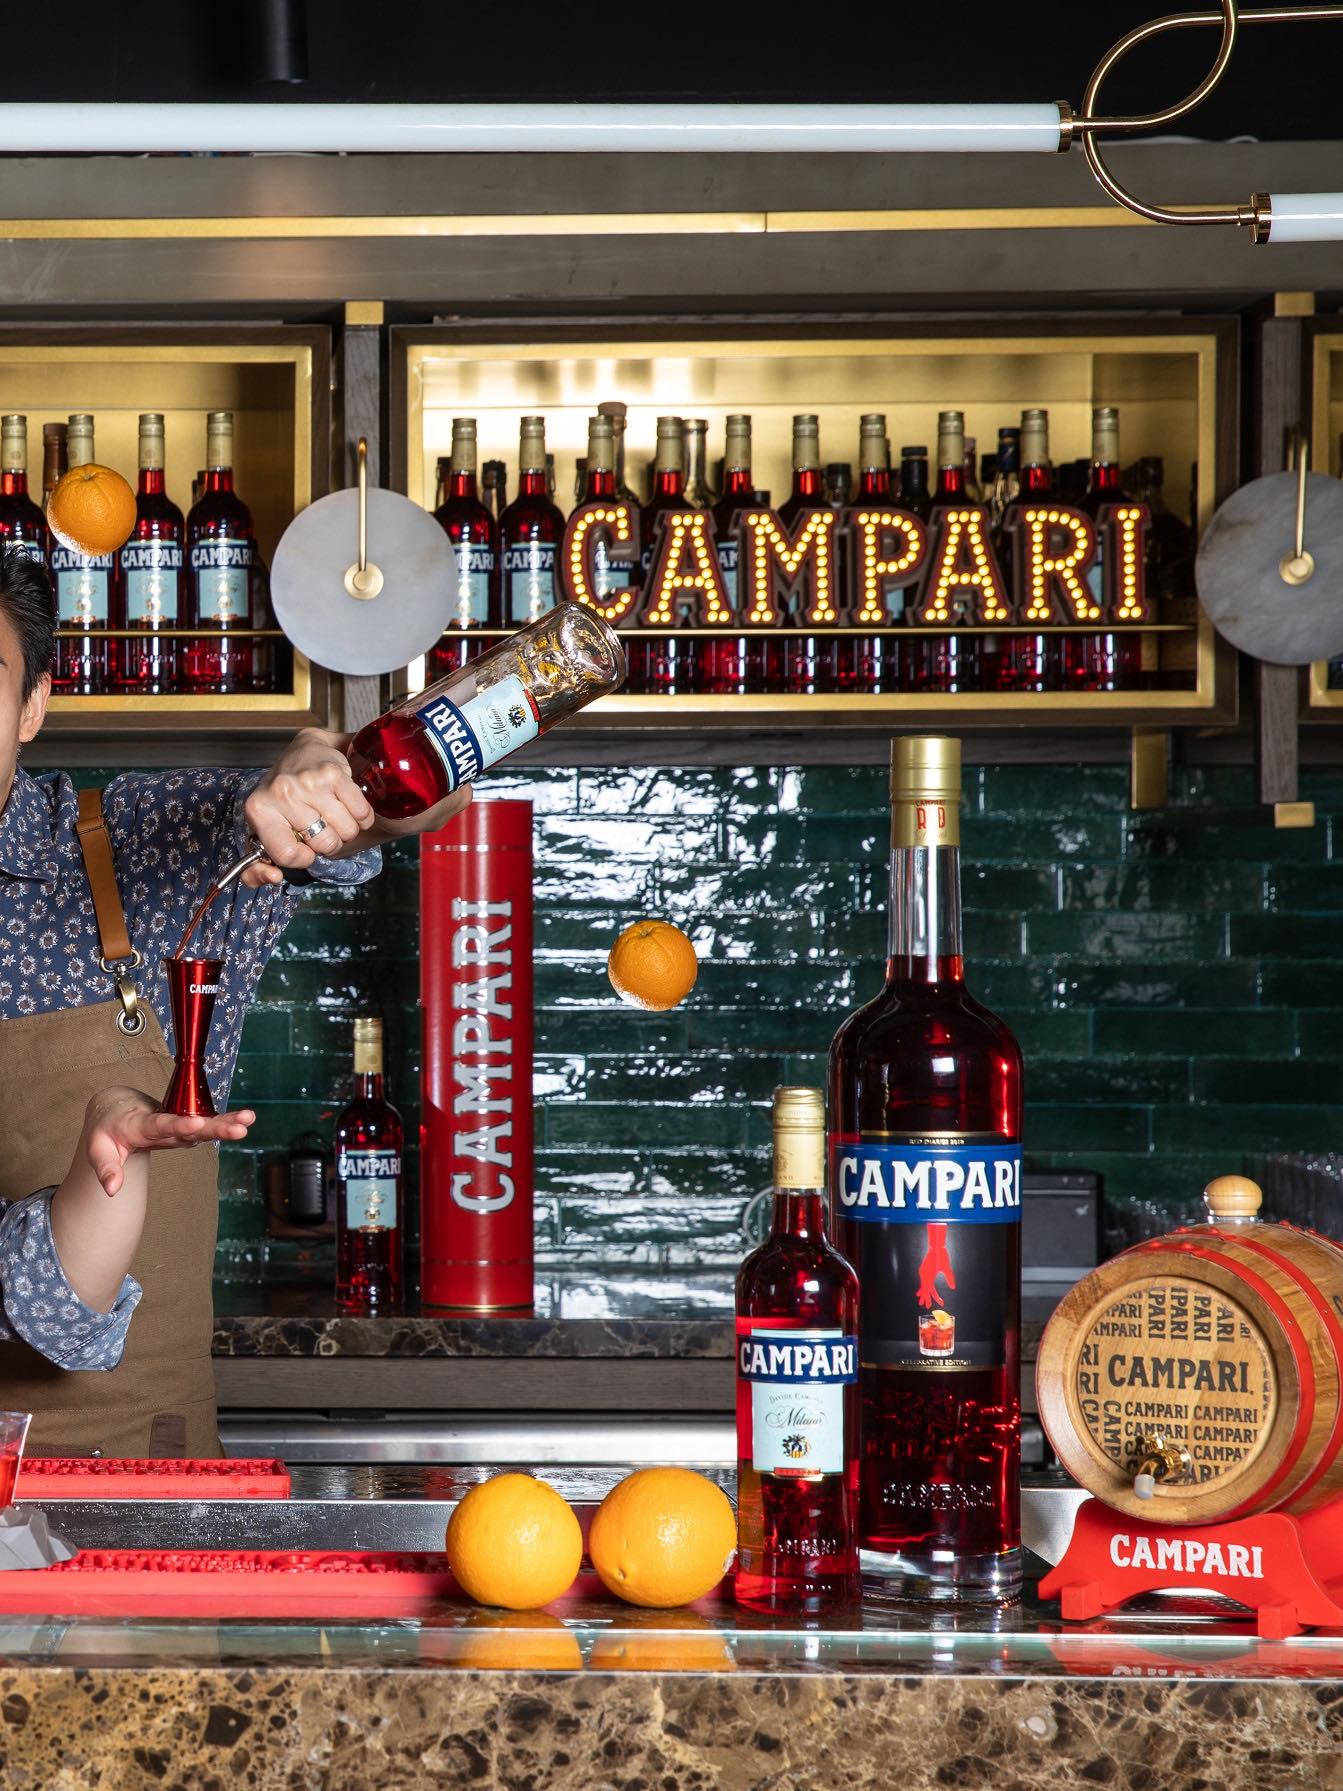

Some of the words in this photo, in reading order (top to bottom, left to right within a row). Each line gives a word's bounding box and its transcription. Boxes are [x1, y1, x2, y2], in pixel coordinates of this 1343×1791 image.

[121, 548, 183, 568] CAMPARI
[192, 547, 253, 567] CAMPARI
[562, 502, 1149, 626] CAMPARI
[424, 703, 478, 787] AMPARI
[451, 896, 515, 1214] CAMPARI
[338, 1157, 402, 1176] CAMPARI
[839, 1156, 1020, 1210] CAMPARI
[740, 1342, 854, 1378] CAMPARI
[1124, 1401, 1189, 1419] CAMPARI
[1193, 1404, 1258, 1423] CAMPARI
[1124, 1421, 1189, 1440] CAMPARI
[1109, 1534, 1264, 1579] CAMPARI
